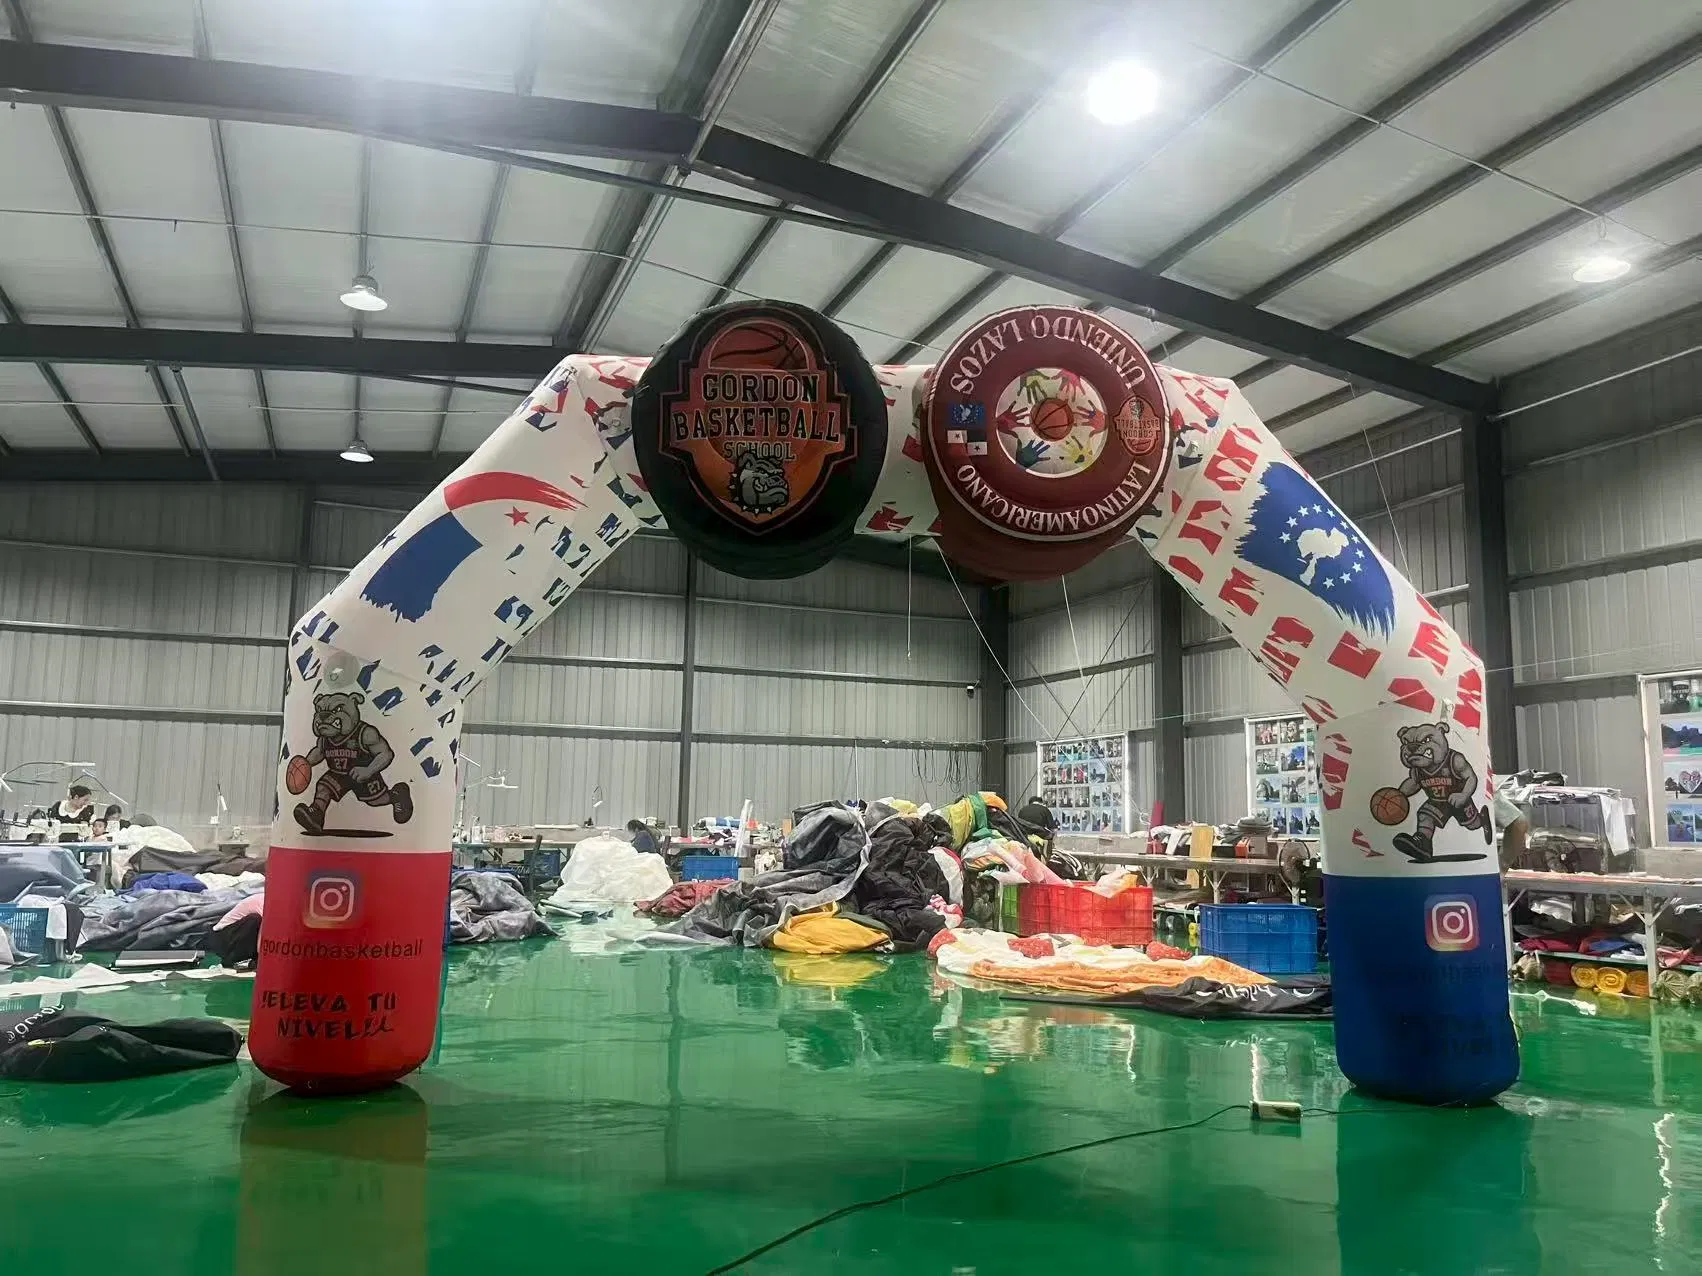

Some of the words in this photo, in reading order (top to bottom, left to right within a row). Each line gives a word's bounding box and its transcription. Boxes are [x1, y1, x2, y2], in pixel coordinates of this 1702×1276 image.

[950, 315, 1024, 395] LAZOS
[1031, 314, 1146, 390] UNIENDO
[702, 373, 819, 403] GORDON
[673, 406, 840, 443] BASKETBALL
[723, 441, 796, 460] SCHOOL
[957, 462, 1151, 532] LATINOAMERICANO
[368, 992, 396, 1011] TU
